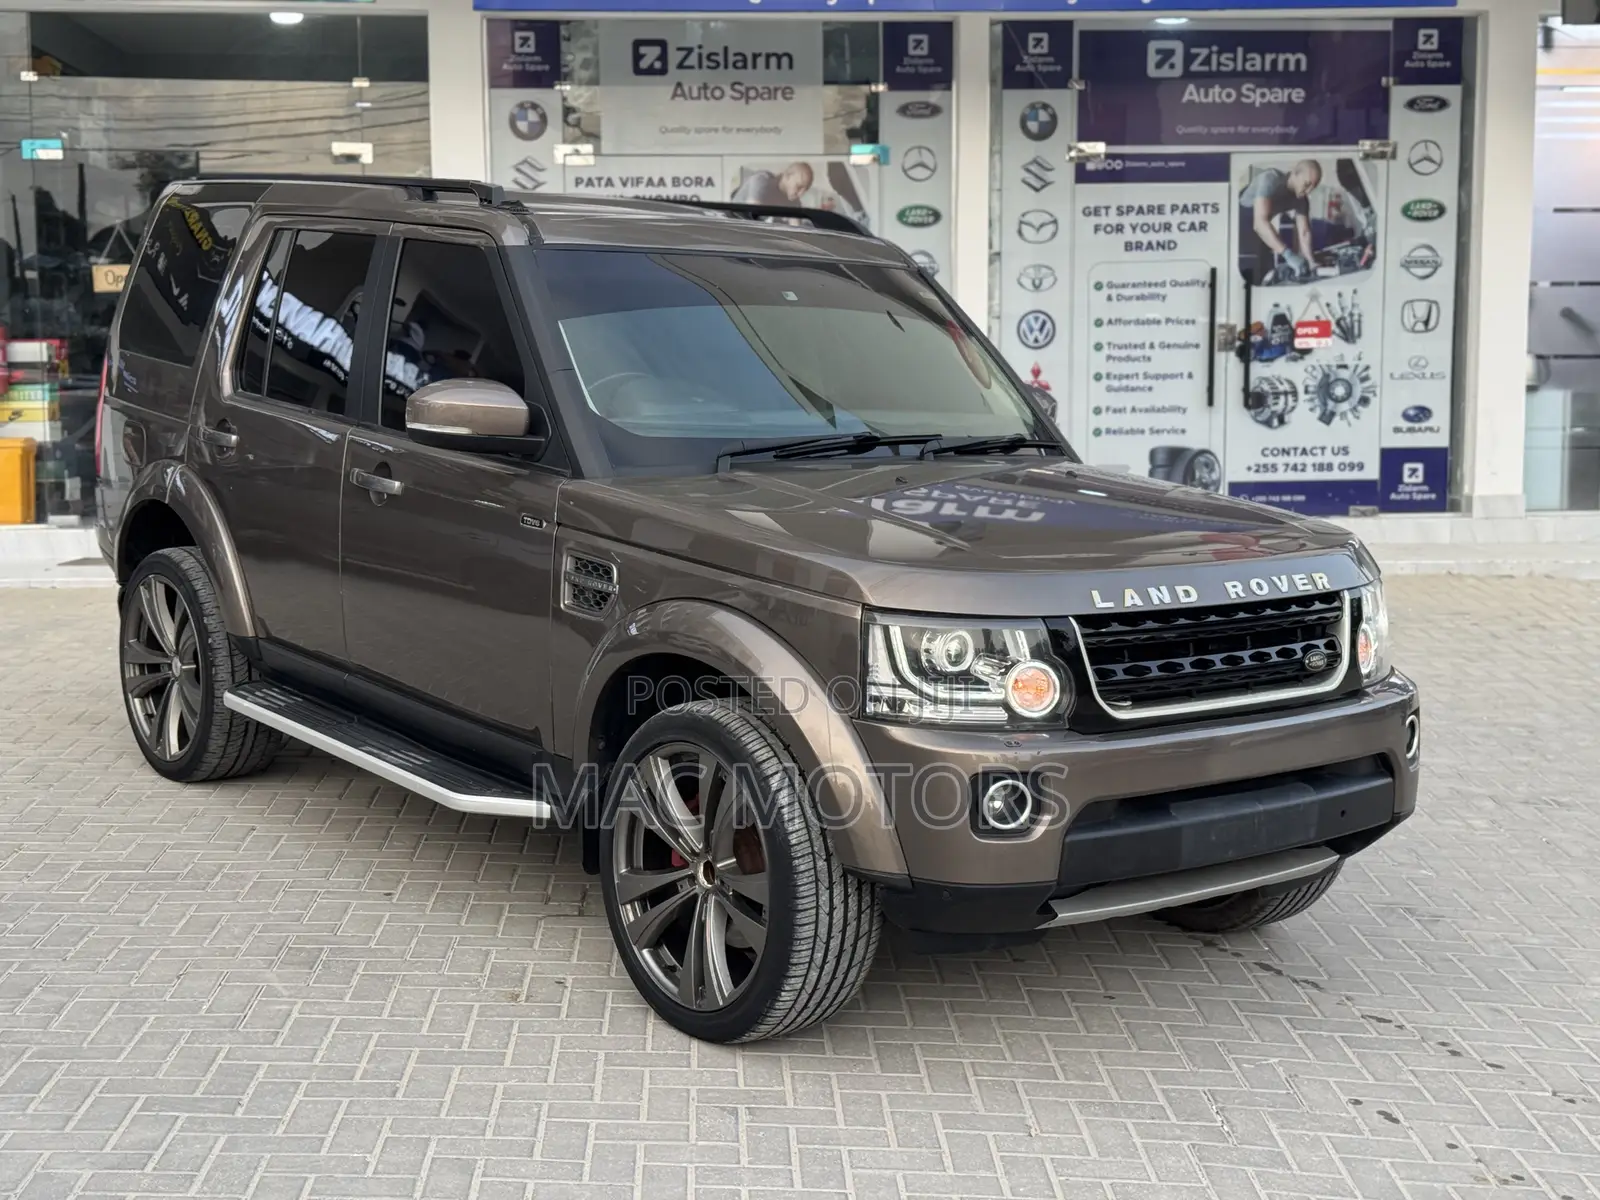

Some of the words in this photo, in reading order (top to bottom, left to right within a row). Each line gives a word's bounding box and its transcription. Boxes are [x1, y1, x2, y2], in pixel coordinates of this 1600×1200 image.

[675, 45, 793, 70] Zislarm
[1189, 46, 1307, 72] Zislarm
[670, 82, 724, 101] Auto
[730, 82, 794, 105] Spare
[1181, 84, 1236, 103] Auto
[1241, 84, 1306, 107] Spare
[721, 125, 733, 134] for
[736, 125, 782, 136] everybody
[1237, 124, 1250, 134] for
[1252, 124, 1299, 136] everybody
[574, 176, 615, 188] PATA
[618, 176, 667, 188] VIFAA
[671, 176, 716, 188] BORA
[1082, 206, 1111, 217] GET
[1116, 204, 1166, 217] SPARE
[1170, 202, 1220, 215] PARTS
[1093, 223, 1125, 235] FOR
[1129, 222, 1173, 234] YOUR
[1177, 221, 1208, 233] CAR
[1124, 240, 1178, 252] BRAND
[104, 269, 125, 289] Op
[1106, 280, 1166, 290] Guaranteed
[1169, 279, 1207, 289] Quality
[1106, 293, 1113, 302] &
[1116, 292, 1167, 303] Durability
[1106, 317, 1162, 327] Affordable
[1165, 317, 1196, 326] Prices
[1106, 341, 1146, 350] Trusted
[1148, 341, 1156, 350] &
[1159, 340, 1201, 350] Genuine
[1105, 354, 1152, 363] Products
[1105, 371, 1139, 382] Expert
[1143, 371, 1184, 382] Support
[1187, 371, 1194, 380] &
[1389, 371, 1447, 381] LEXUS
[1105, 384, 1153, 393] Guidance
[1105, 405, 1127, 414] Fast
[1130, 405, 1188, 416] Availability
[1105, 427, 1146, 436] Reliable
[1149, 426, 1186, 436] Service
[1392, 425, 1441, 434] SUBARU
[1260, 446, 1327, 458] CONTACT
[1331, 446, 1350, 457] US
[1245, 463, 1278, 473] +255
[1283, 463, 1307, 473] 742
[1312, 462, 1334, 473] 188
[1338, 462, 1365, 473] 099
[1389, 493, 1411, 501] Auto
[1412, 493, 1437, 502] Spare
[1090, 585, 1199, 609] LAND
[1223, 572, 1331, 599] ROVER
